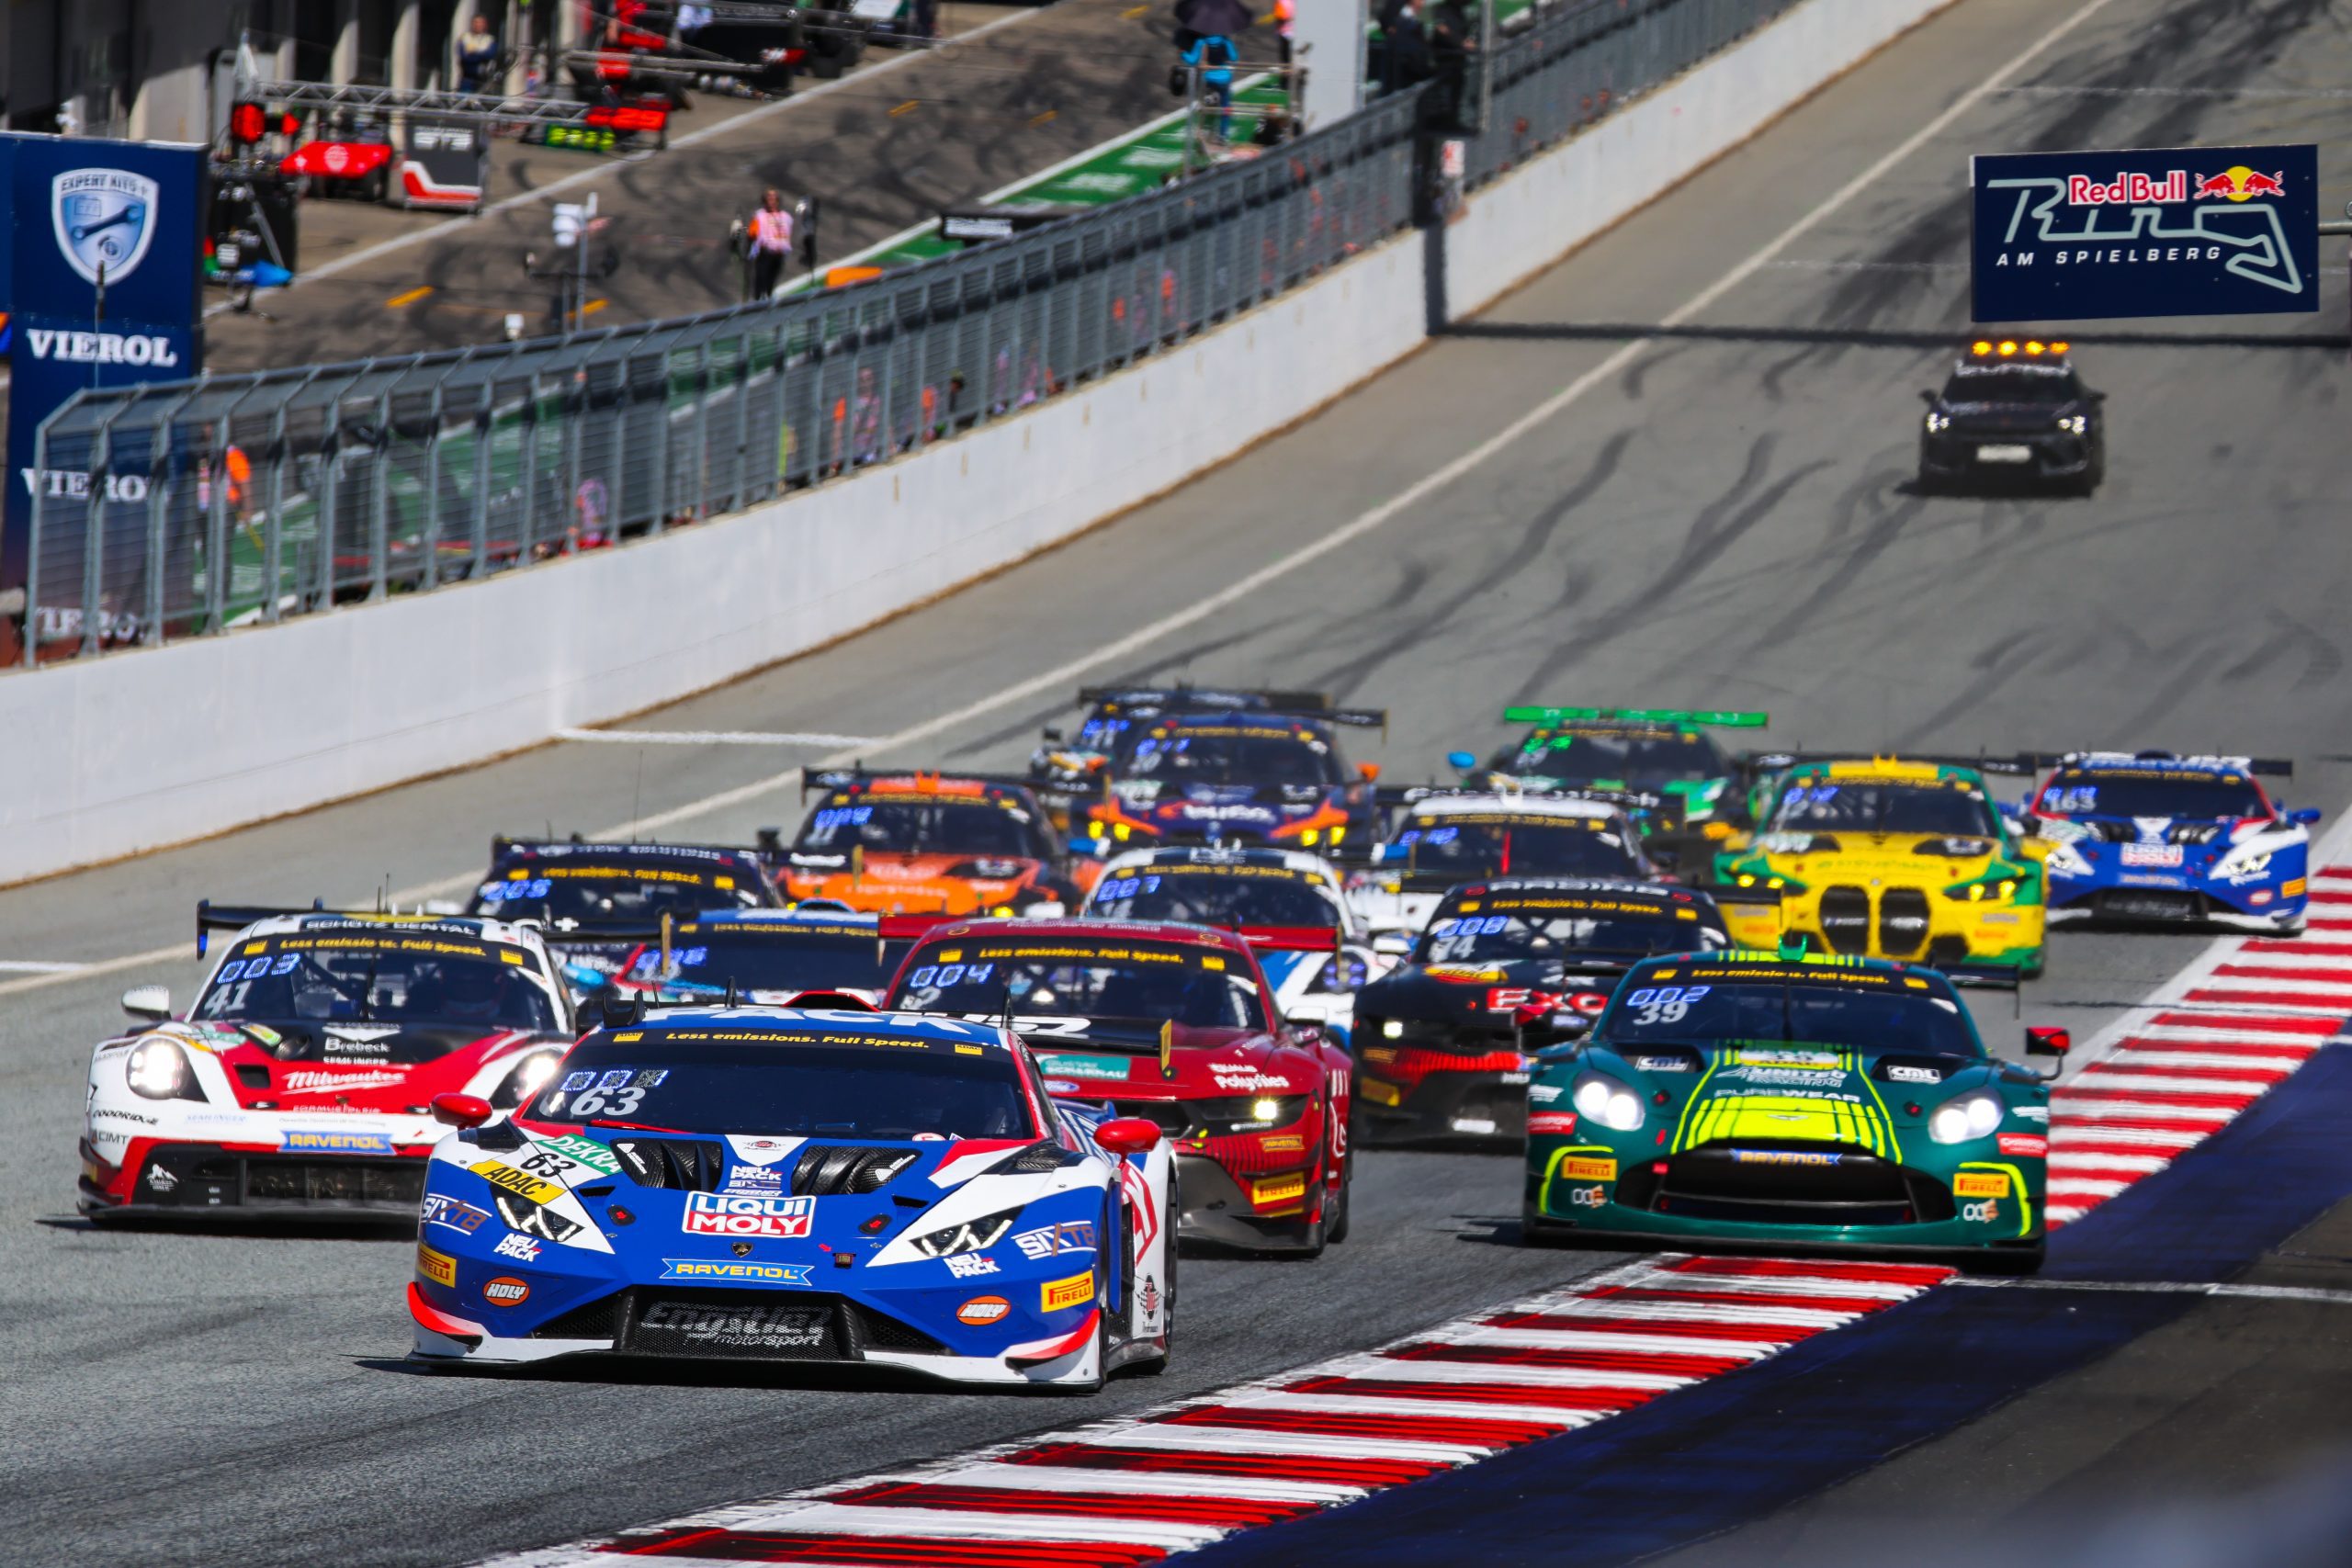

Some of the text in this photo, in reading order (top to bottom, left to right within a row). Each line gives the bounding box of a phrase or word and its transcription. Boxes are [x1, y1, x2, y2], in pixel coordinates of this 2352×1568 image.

[2070, 170, 2187, 204] Red Bull
[1996, 245, 2221, 266] AM SPIELBERG
[26, 328, 178, 367] VIEROL
[978, 948, 1012, 958] Less
[910, 963, 994, 987] 004
[1808, 971, 1838, 981] Full
[1839, 973, 1890, 985] Speed.
[204, 980, 253, 1016] 41
[1627, 986, 1712, 1007] 002
[1633, 999, 1690, 1026] 39
[712, 1032, 817, 1043] emissions.
[822, 1035, 861, 1044] Full
[863, 1036, 931, 1049] Speed.
[281, 1069, 406, 1090] Milwaukee
[570, 1086, 646, 1116] 63
[1713, 1088, 1861, 1104] PUREWEAR
[289, 1134, 386, 1149] RAVENOL
[548, 1135, 622, 1173] DEKRA
[1738, 1151, 1834, 1167] RAVENOL
[520, 1152, 577, 1178] 63
[1568, 1160, 1611, 1177] PIRELLI
[483, 1166, 548, 1195] ADAC
[1959, 1178, 2004, 1192] PIRELLI
[695, 1195, 807, 1217] LIQUI
[691, 1213, 808, 1235] MOLY
[503, 1232, 539, 1250] NEU
[492, 1242, 542, 1263] PACK
[943, 1252, 985, 1267] NEU
[675, 1263, 798, 1280] RAVENOL
[949, 1261, 1002, 1280] PACK
[486, 1283, 526, 1301] HOLY
[1048, 1277, 1091, 1306] PIRELLI
